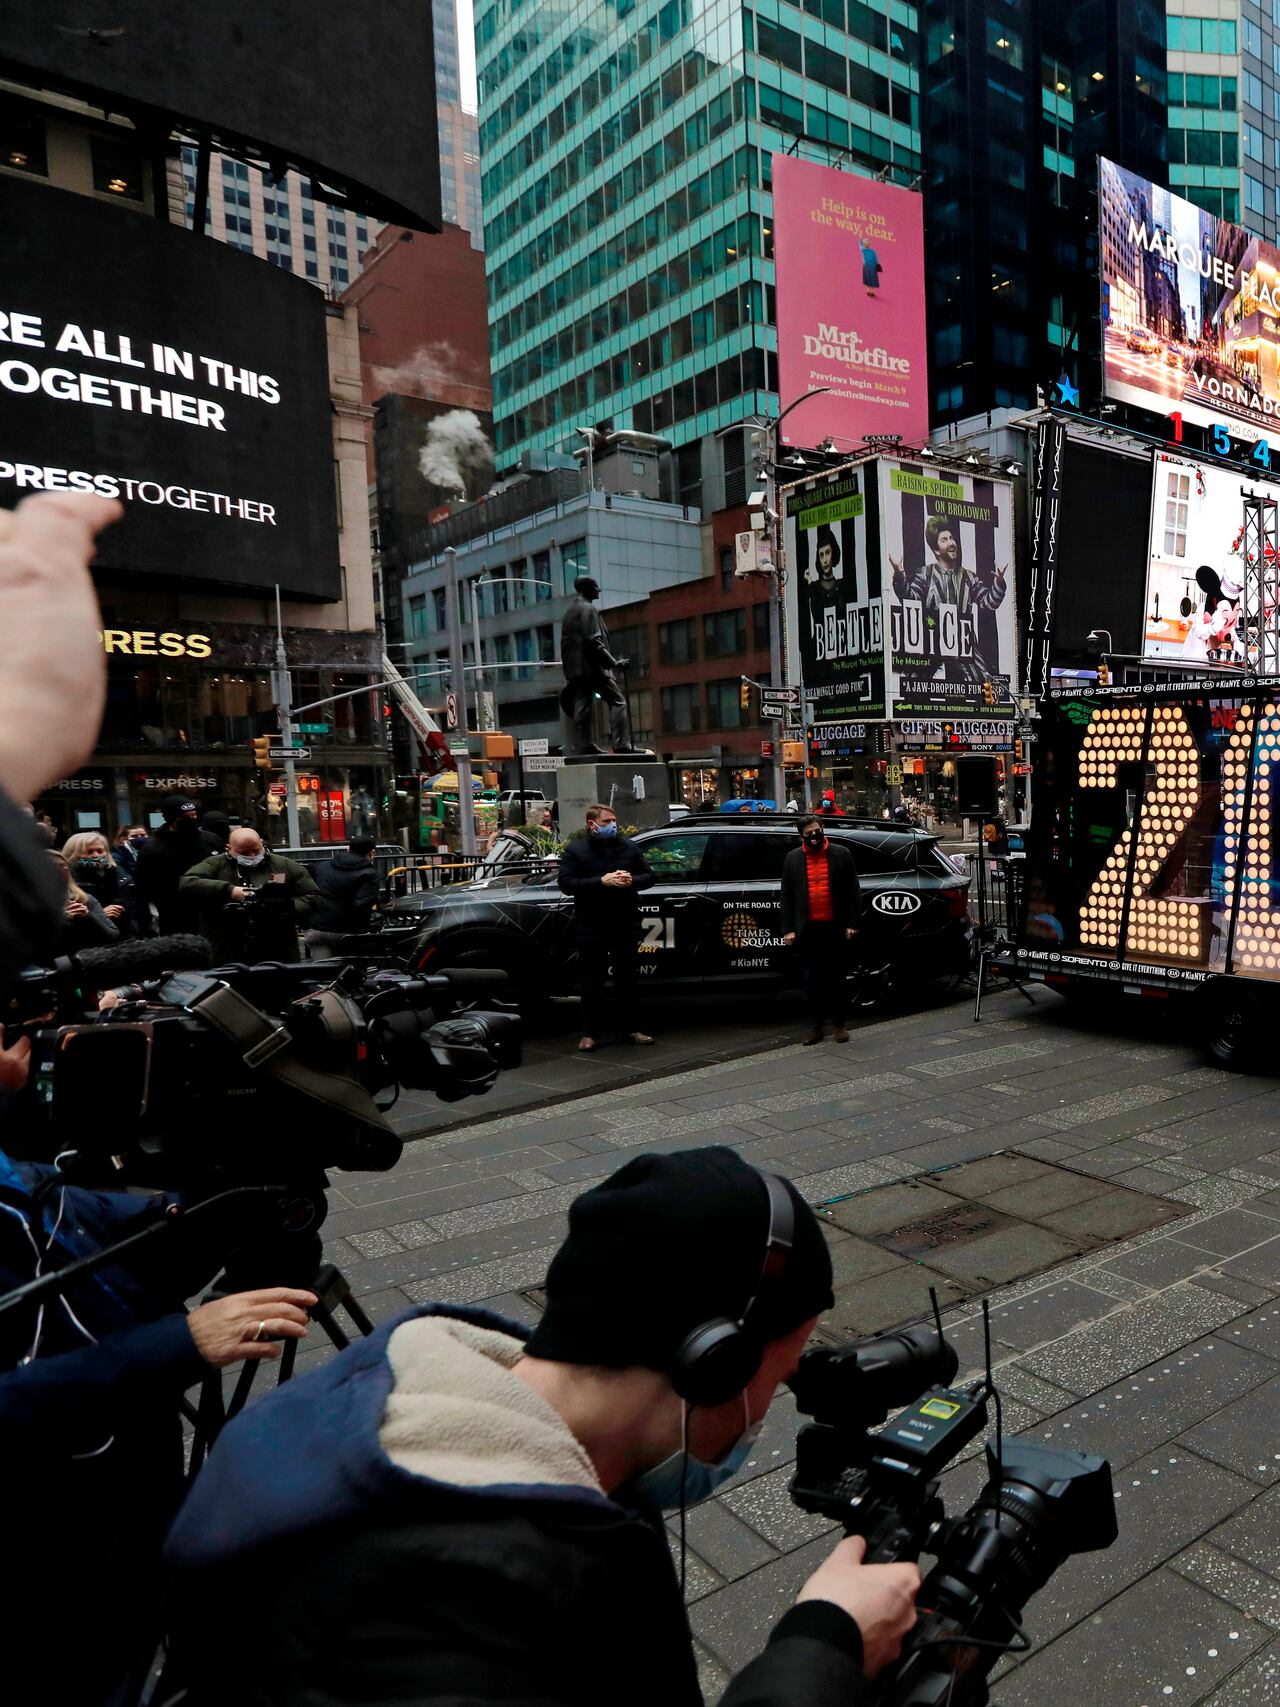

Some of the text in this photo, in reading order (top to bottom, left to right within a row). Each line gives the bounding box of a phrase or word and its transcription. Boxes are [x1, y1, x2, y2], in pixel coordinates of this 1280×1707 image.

[821, 197, 886, 226] Help is on
[811, 210, 896, 242] the way, dear.
[1128, 216, 1235, 290] MARQUEE
[818, 323, 863, 344] Mrs.
[56, 323, 281, 404] ALL IN THIS
[803, 335, 910, 373] Doubtfire
[810, 371, 906, 395] Previews begin March 9
[1209, 398, 1273, 424] REALTY TRUST
[896, 474, 958, 499] RAISING SPIRITS
[934, 499, 991, 521] ON BROADWAY!
[815, 604, 883, 661] BEETLE
[891, 657, 903, 666] The
[835, 682, 850, 694] GOOD
[912, 681, 966, 695] JAW-DROPPING
[1095, 685, 1142, 695] SORENTO
[1155, 684, 1166, 692] GIVE
[1172, 682, 1201, 691] EVERYTHING
[1215, 679, 1240, 689] #KiaNYE
[813, 724, 866, 741] LUGGAGE
[901, 722, 942, 734] GIFTS
[953, 722, 1014, 736] LUGGAGE
[145, 777, 217, 789] EXPRESS
[880, 895, 914, 911] KIA
[641, 917, 675, 949] 21
[736, 928, 771, 938] TIMES
[742, 937, 786, 948] SQUARE
[731, 958, 770, 967] #KiaNYE
[1028, 949, 1206, 982] #KiaNYE SORENTO GIVE EVERYTHING #KiaNYE
